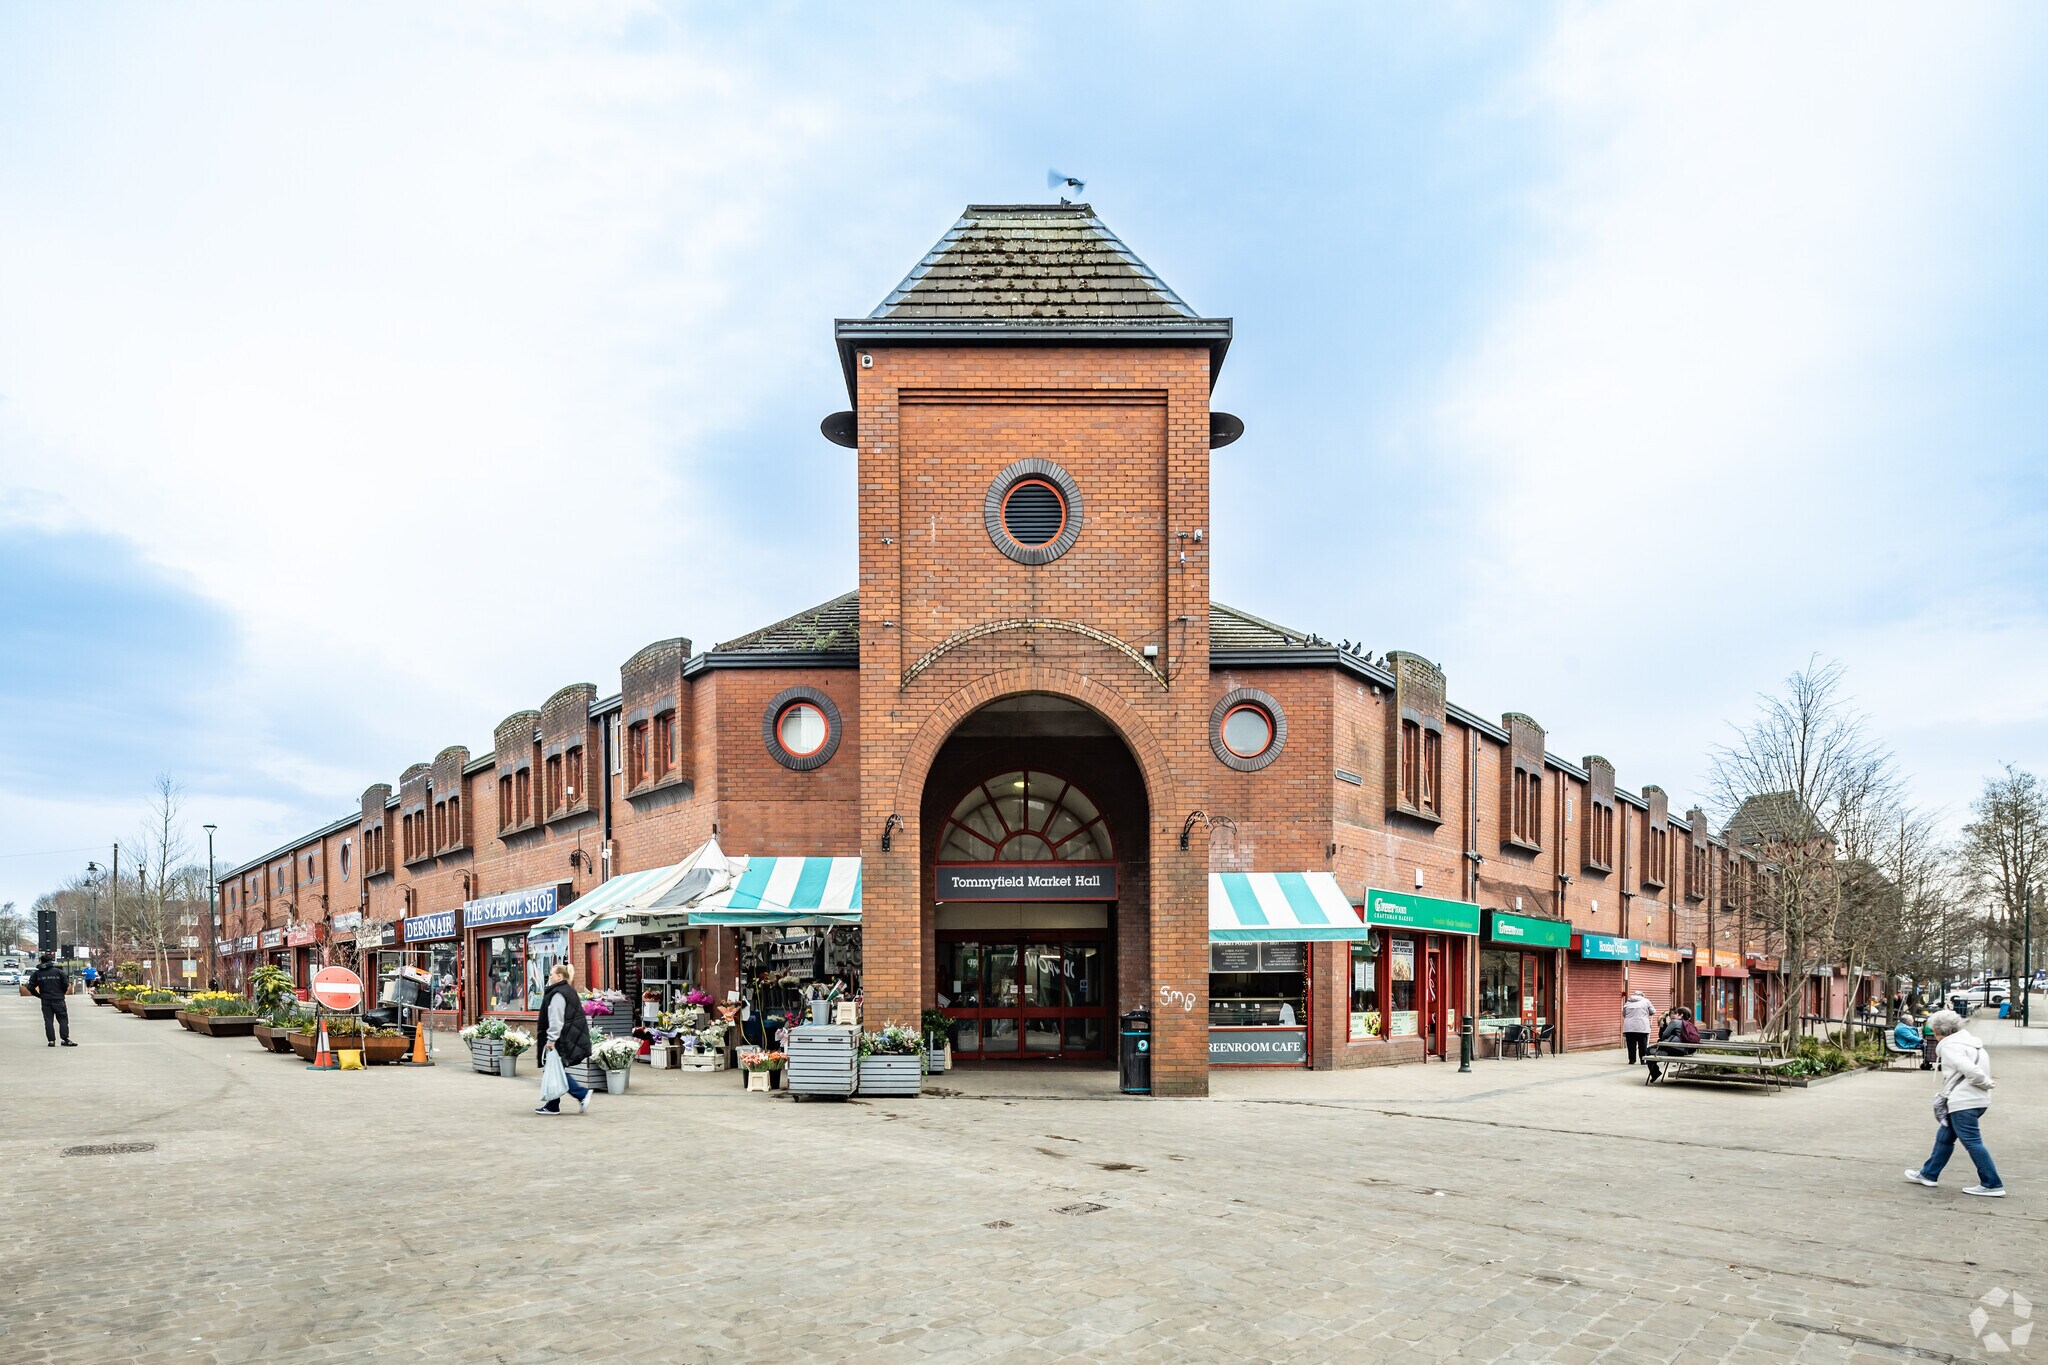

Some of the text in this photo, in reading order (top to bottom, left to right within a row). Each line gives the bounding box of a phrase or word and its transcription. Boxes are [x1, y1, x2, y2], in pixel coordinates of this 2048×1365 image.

[952, 875, 1100, 889] Tommyfield Market Hall
[465, 893, 553, 923] THE SCHOOL SHOP
[407, 916, 453, 938] DEBONAIR
[1599, 940, 1614, 955] Housing
[1208, 1041, 1301, 1053] REENROOM CAFE
